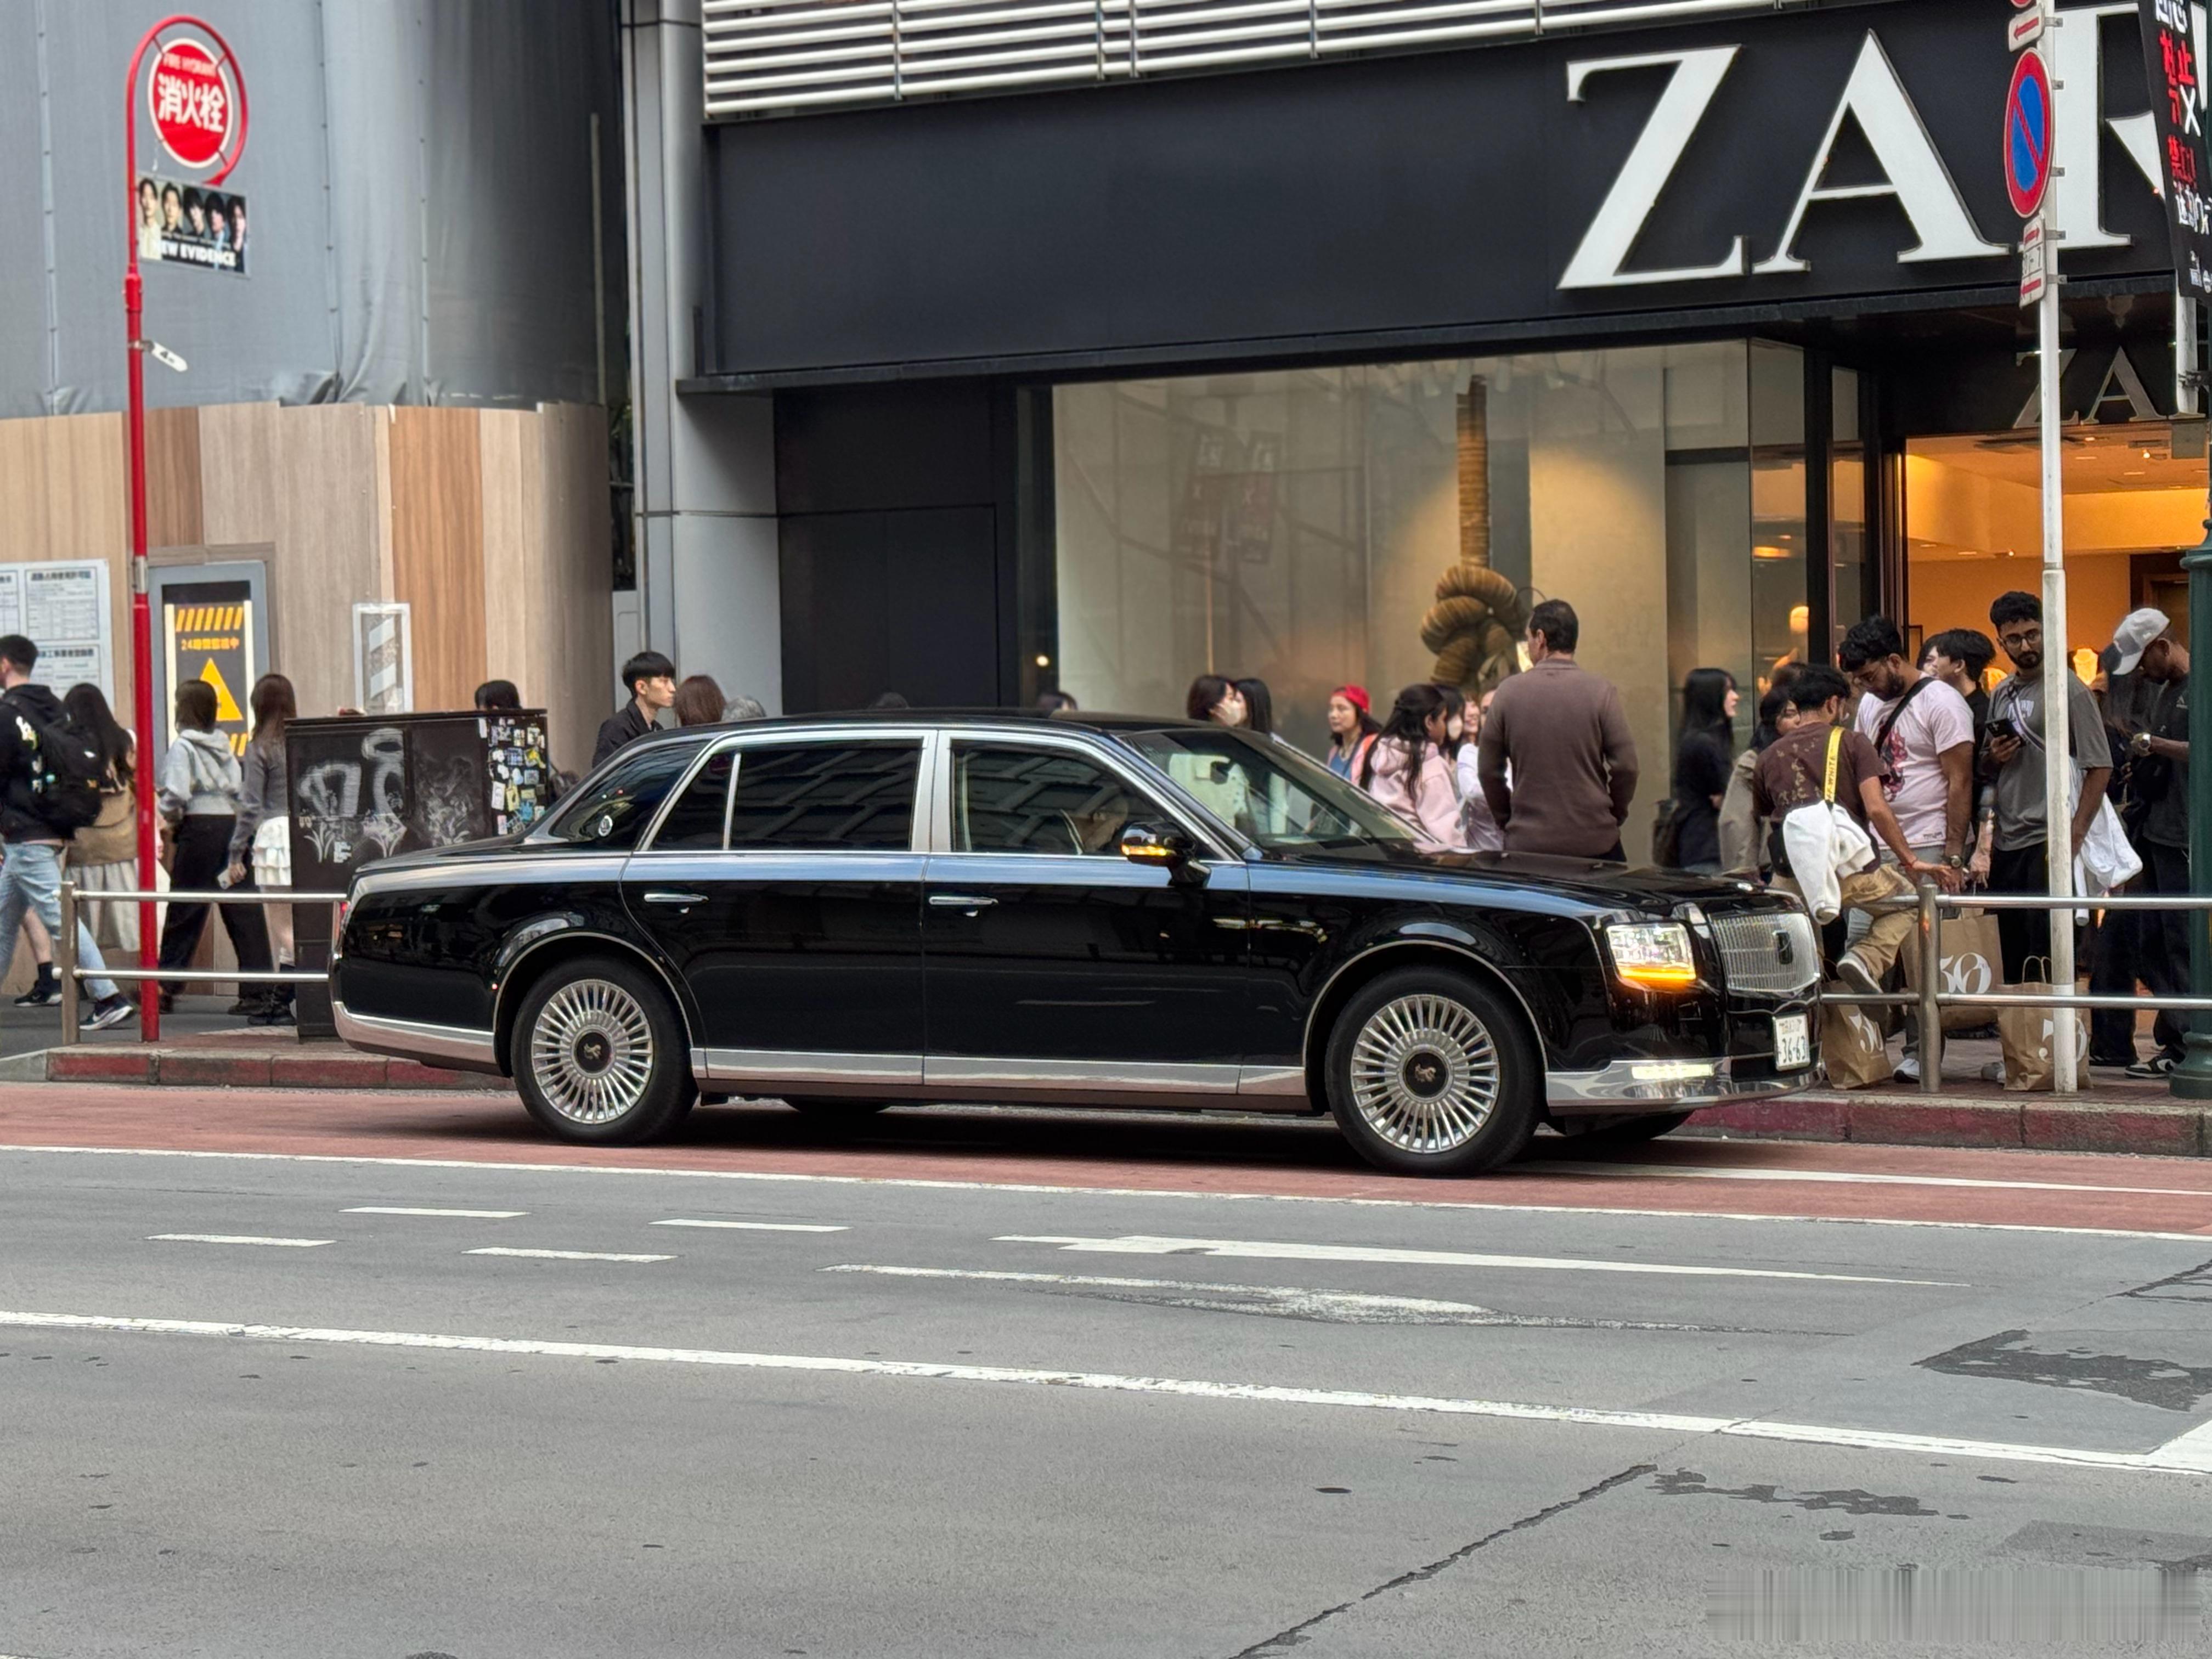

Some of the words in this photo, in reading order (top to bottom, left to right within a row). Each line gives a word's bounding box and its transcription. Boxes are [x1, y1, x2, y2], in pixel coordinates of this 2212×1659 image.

[157, 72, 225, 133] 消火栓
[2012, 345, 2206, 429] ZA
[1782, 1035, 1806, 1064] 36-63
